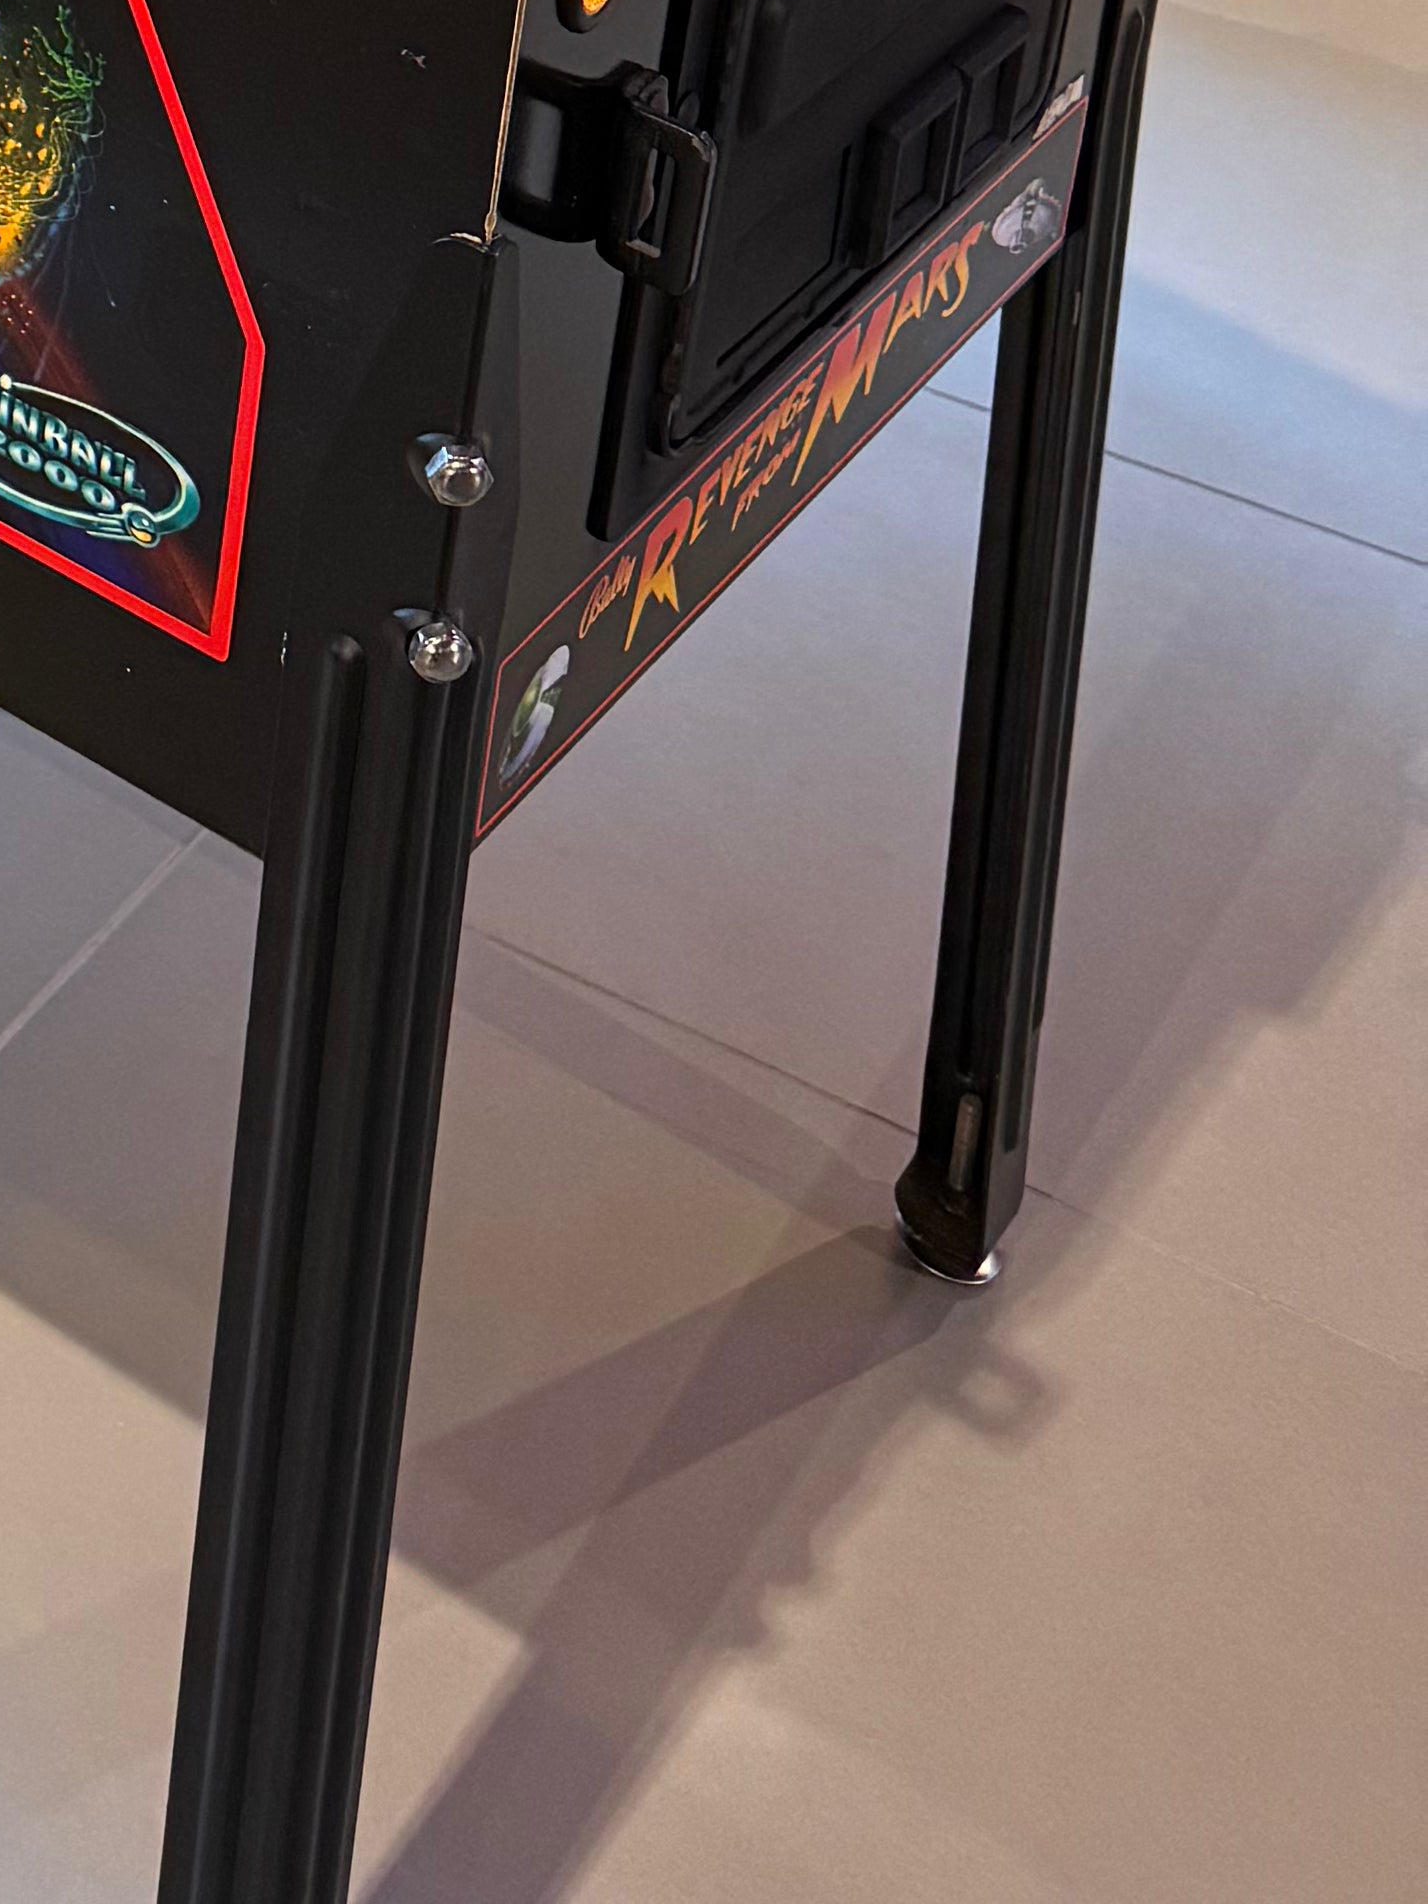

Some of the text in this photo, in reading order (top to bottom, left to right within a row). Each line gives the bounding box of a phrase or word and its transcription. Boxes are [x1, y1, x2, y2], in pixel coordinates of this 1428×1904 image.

[578, 220, 986, 652] Bally REVENGE MARS
